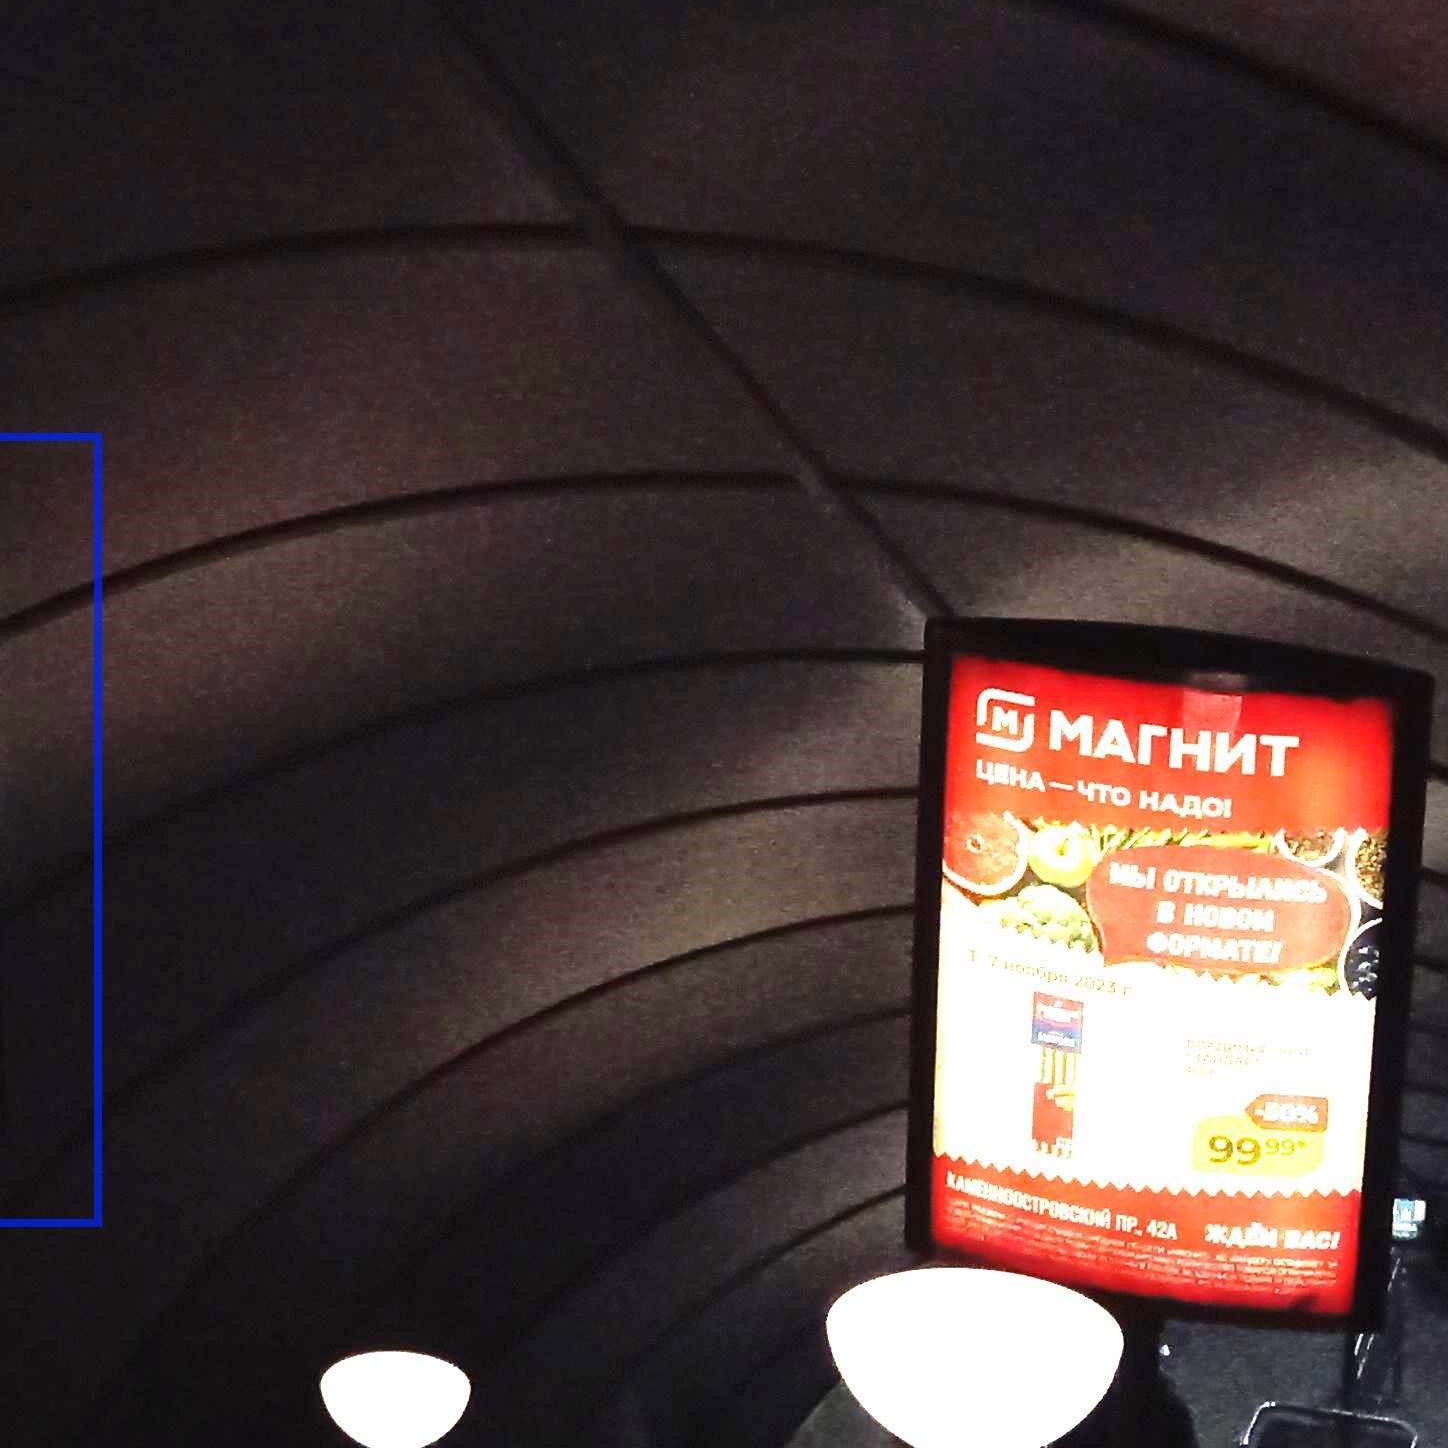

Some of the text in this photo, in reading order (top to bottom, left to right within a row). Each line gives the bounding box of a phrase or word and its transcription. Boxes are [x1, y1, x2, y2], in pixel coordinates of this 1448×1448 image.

[1048, 709, 1300, 777] МАГНИТ
[975, 758, 1046, 793] ЦЕНА
[1077, 780, 1131, 807] ЧТО
[1138, 790, 1233, 820] НАДО!
[1108, 860, 1328, 904] МЫ ОТКРЫЛИСЬ
[1156, 899, 1275, 933] В НОВОМ
[1145, 931, 1284, 965] ФОРМАТЕ!
[1146, 1219, 1178, 1241] 42А
[1205, 1221, 1278, 1249] ЖДЁМ
[1284, 1229, 1341, 1250] ВАС!
